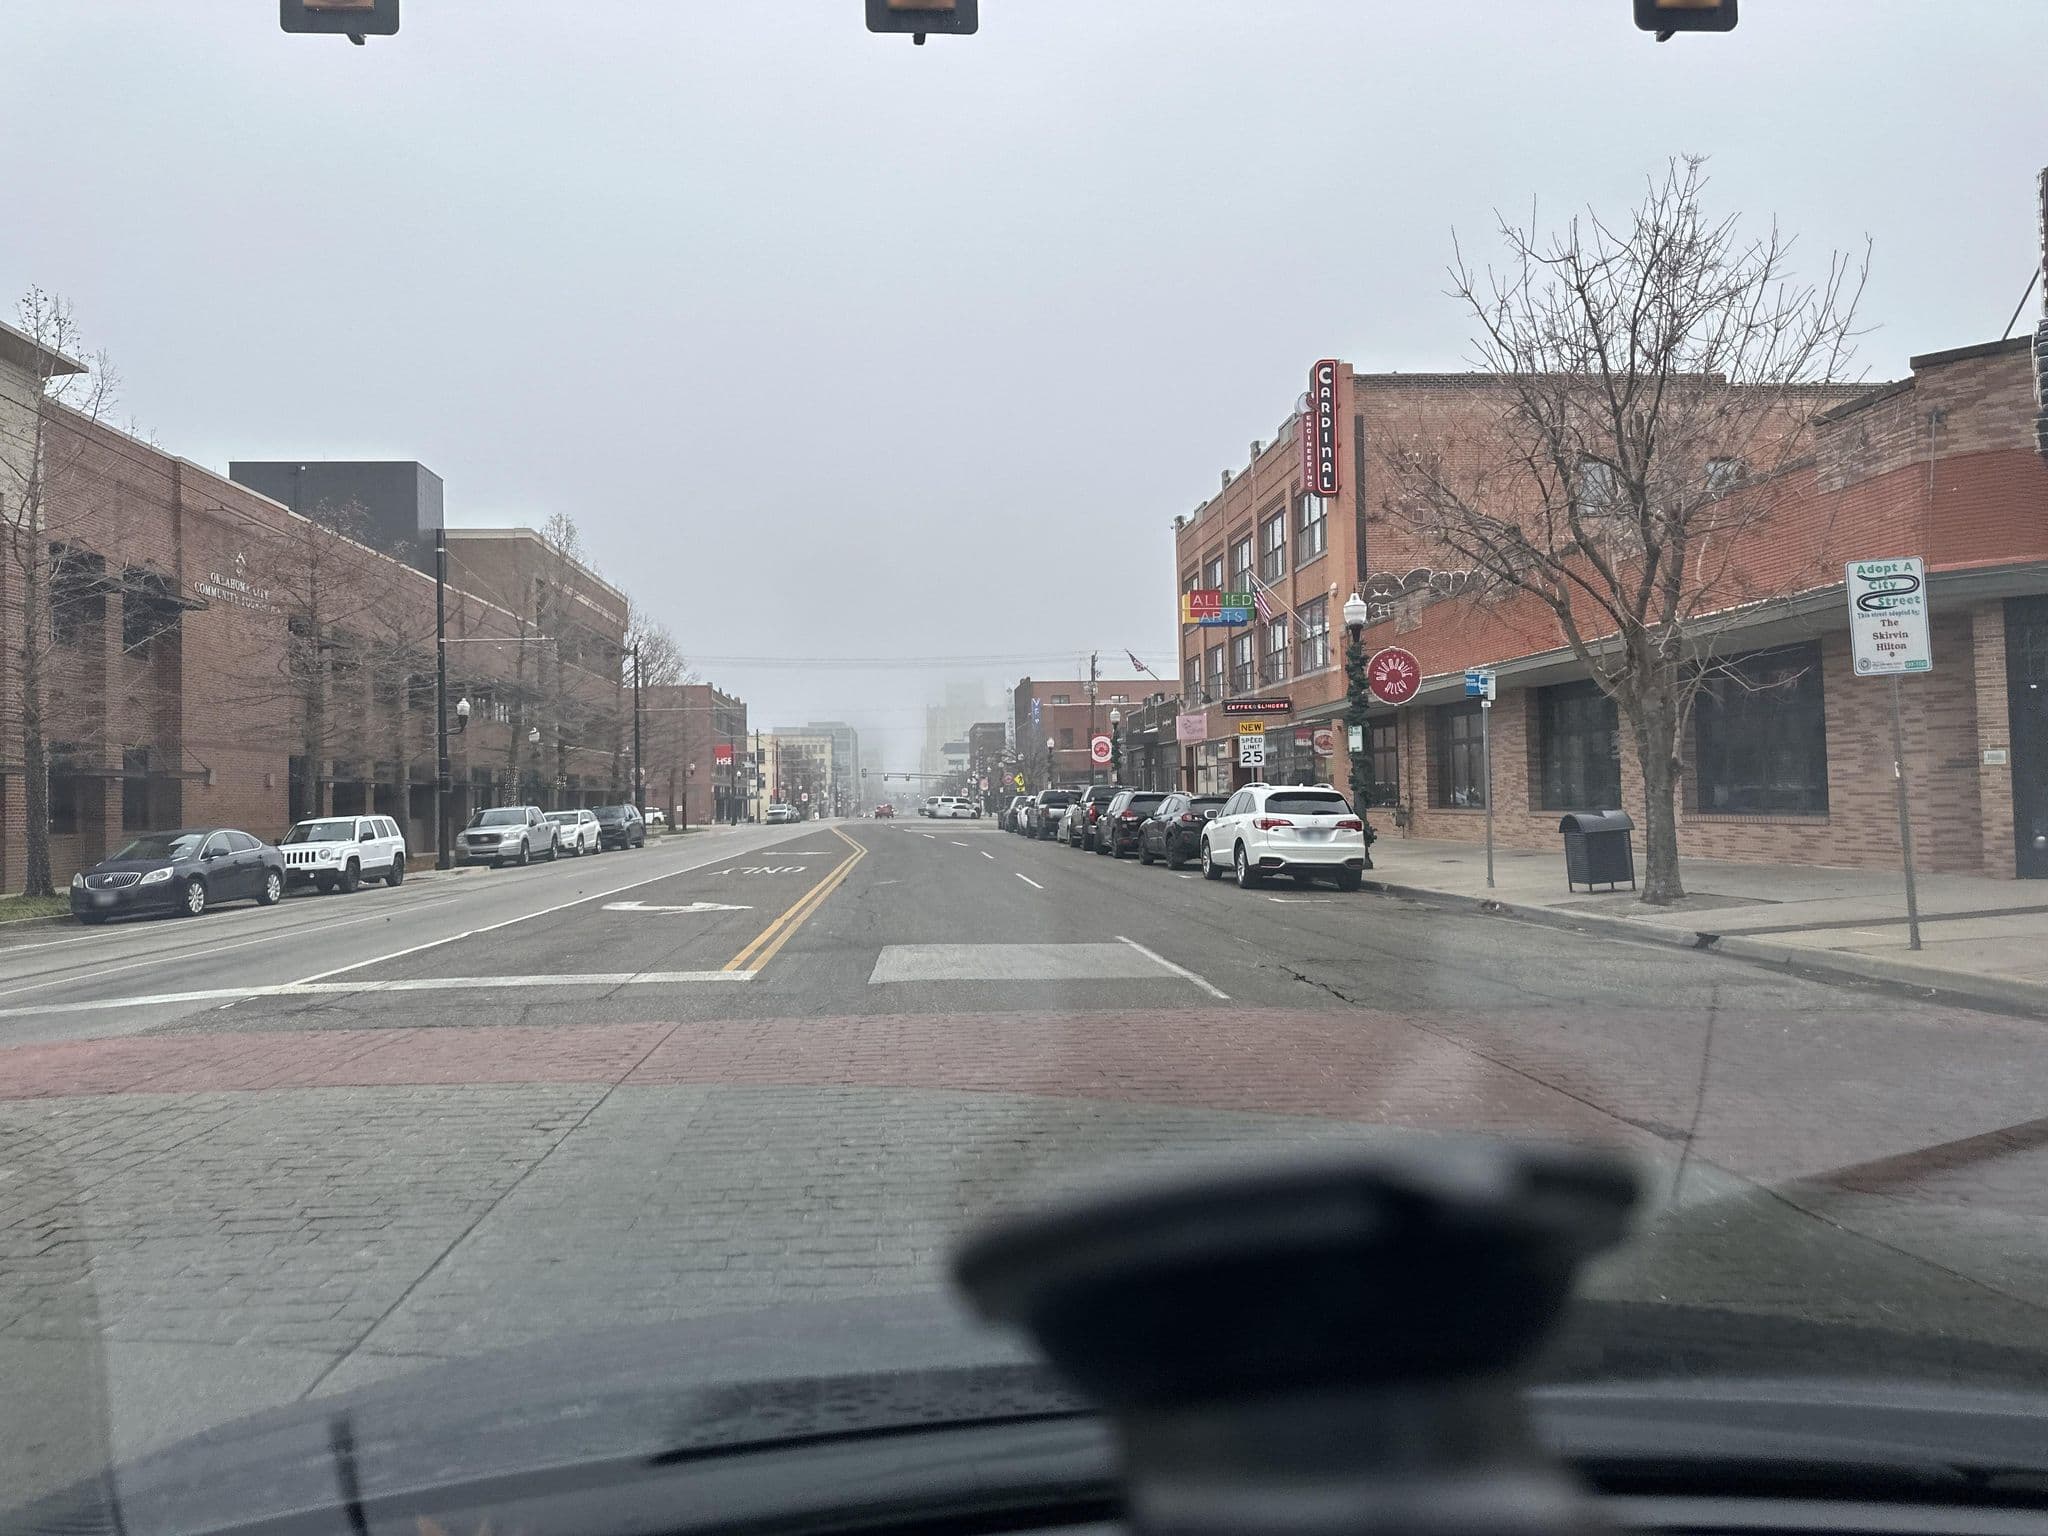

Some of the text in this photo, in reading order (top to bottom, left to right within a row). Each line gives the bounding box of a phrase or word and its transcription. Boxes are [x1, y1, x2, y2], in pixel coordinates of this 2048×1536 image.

[1318, 367, 1332, 488] CARDINAL
[1857, 562, 1913, 575] Adopt A
[1868, 581, 1897, 591] City
[194, 581, 239, 604] COMMUNITY
[1192, 594, 1252, 607] ALLIED
[1878, 595, 1921, 606] Street
[1200, 611, 1243, 623] ARTS
[1889, 609, 1911, 617] adopted
[1880, 619, 1899, 627] The
[1872, 631, 1909, 640] Skirvin
[1876, 643, 1907, 651] Hilton
[1384, 680, 1407, 695] ALLEY
[1241, 723, 1262, 732] NEW
[1242, 751, 1263, 763] 25
